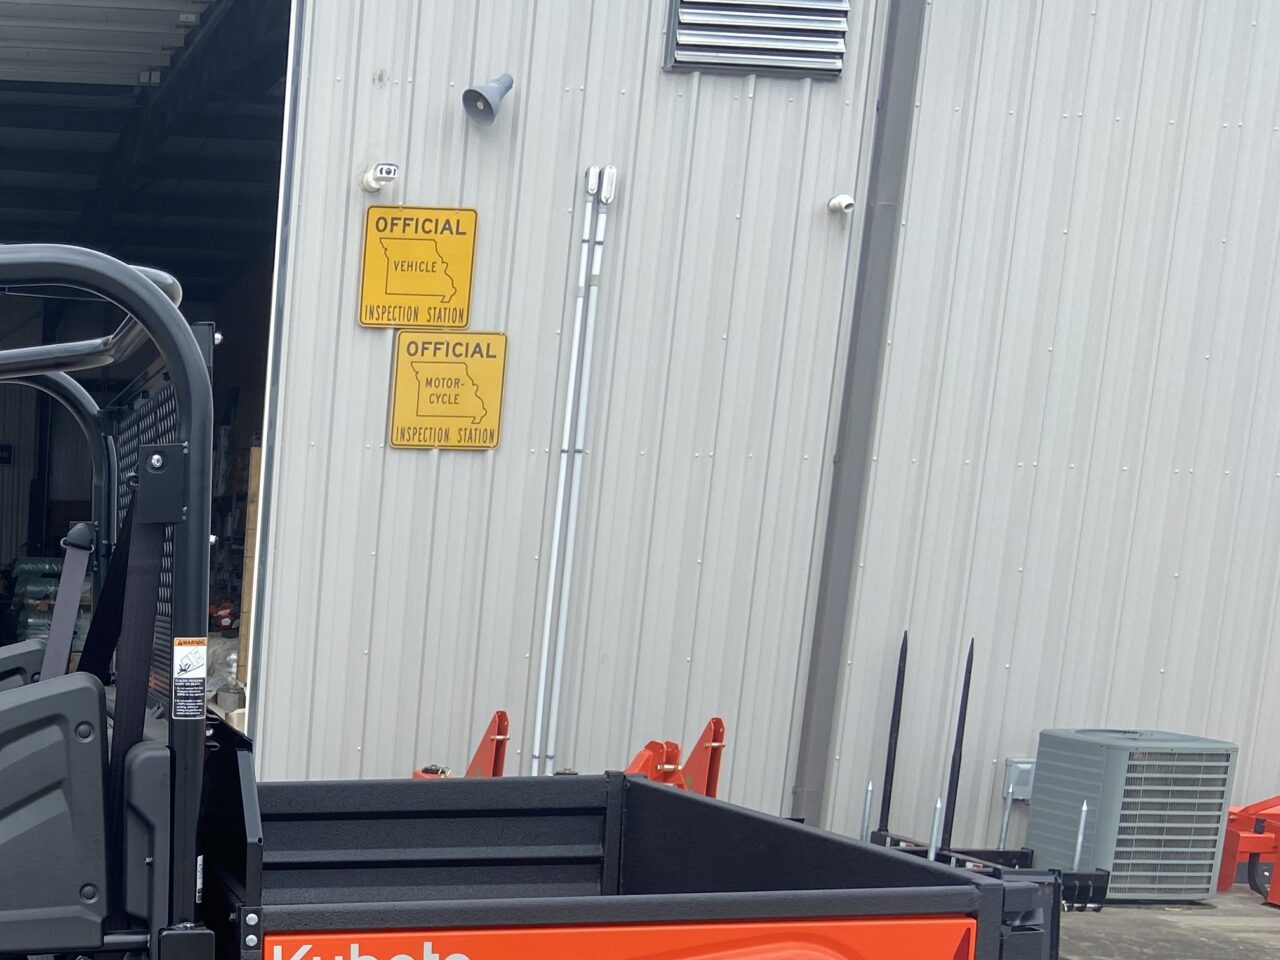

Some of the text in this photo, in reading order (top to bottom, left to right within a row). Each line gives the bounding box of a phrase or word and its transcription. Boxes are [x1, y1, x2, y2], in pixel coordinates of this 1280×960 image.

[375, 216, 467, 236] OFFICIAL
[393, 260, 437, 273] VEHICLE
[364, 304, 465, 325] INSPECTION STATION
[406, 340, 497, 359] OFFICIAL
[425, 377, 465, 389] MOTOR-
[429, 393, 460, 405] CYCLE
[395, 426, 495, 444] INSPECTION STATION
